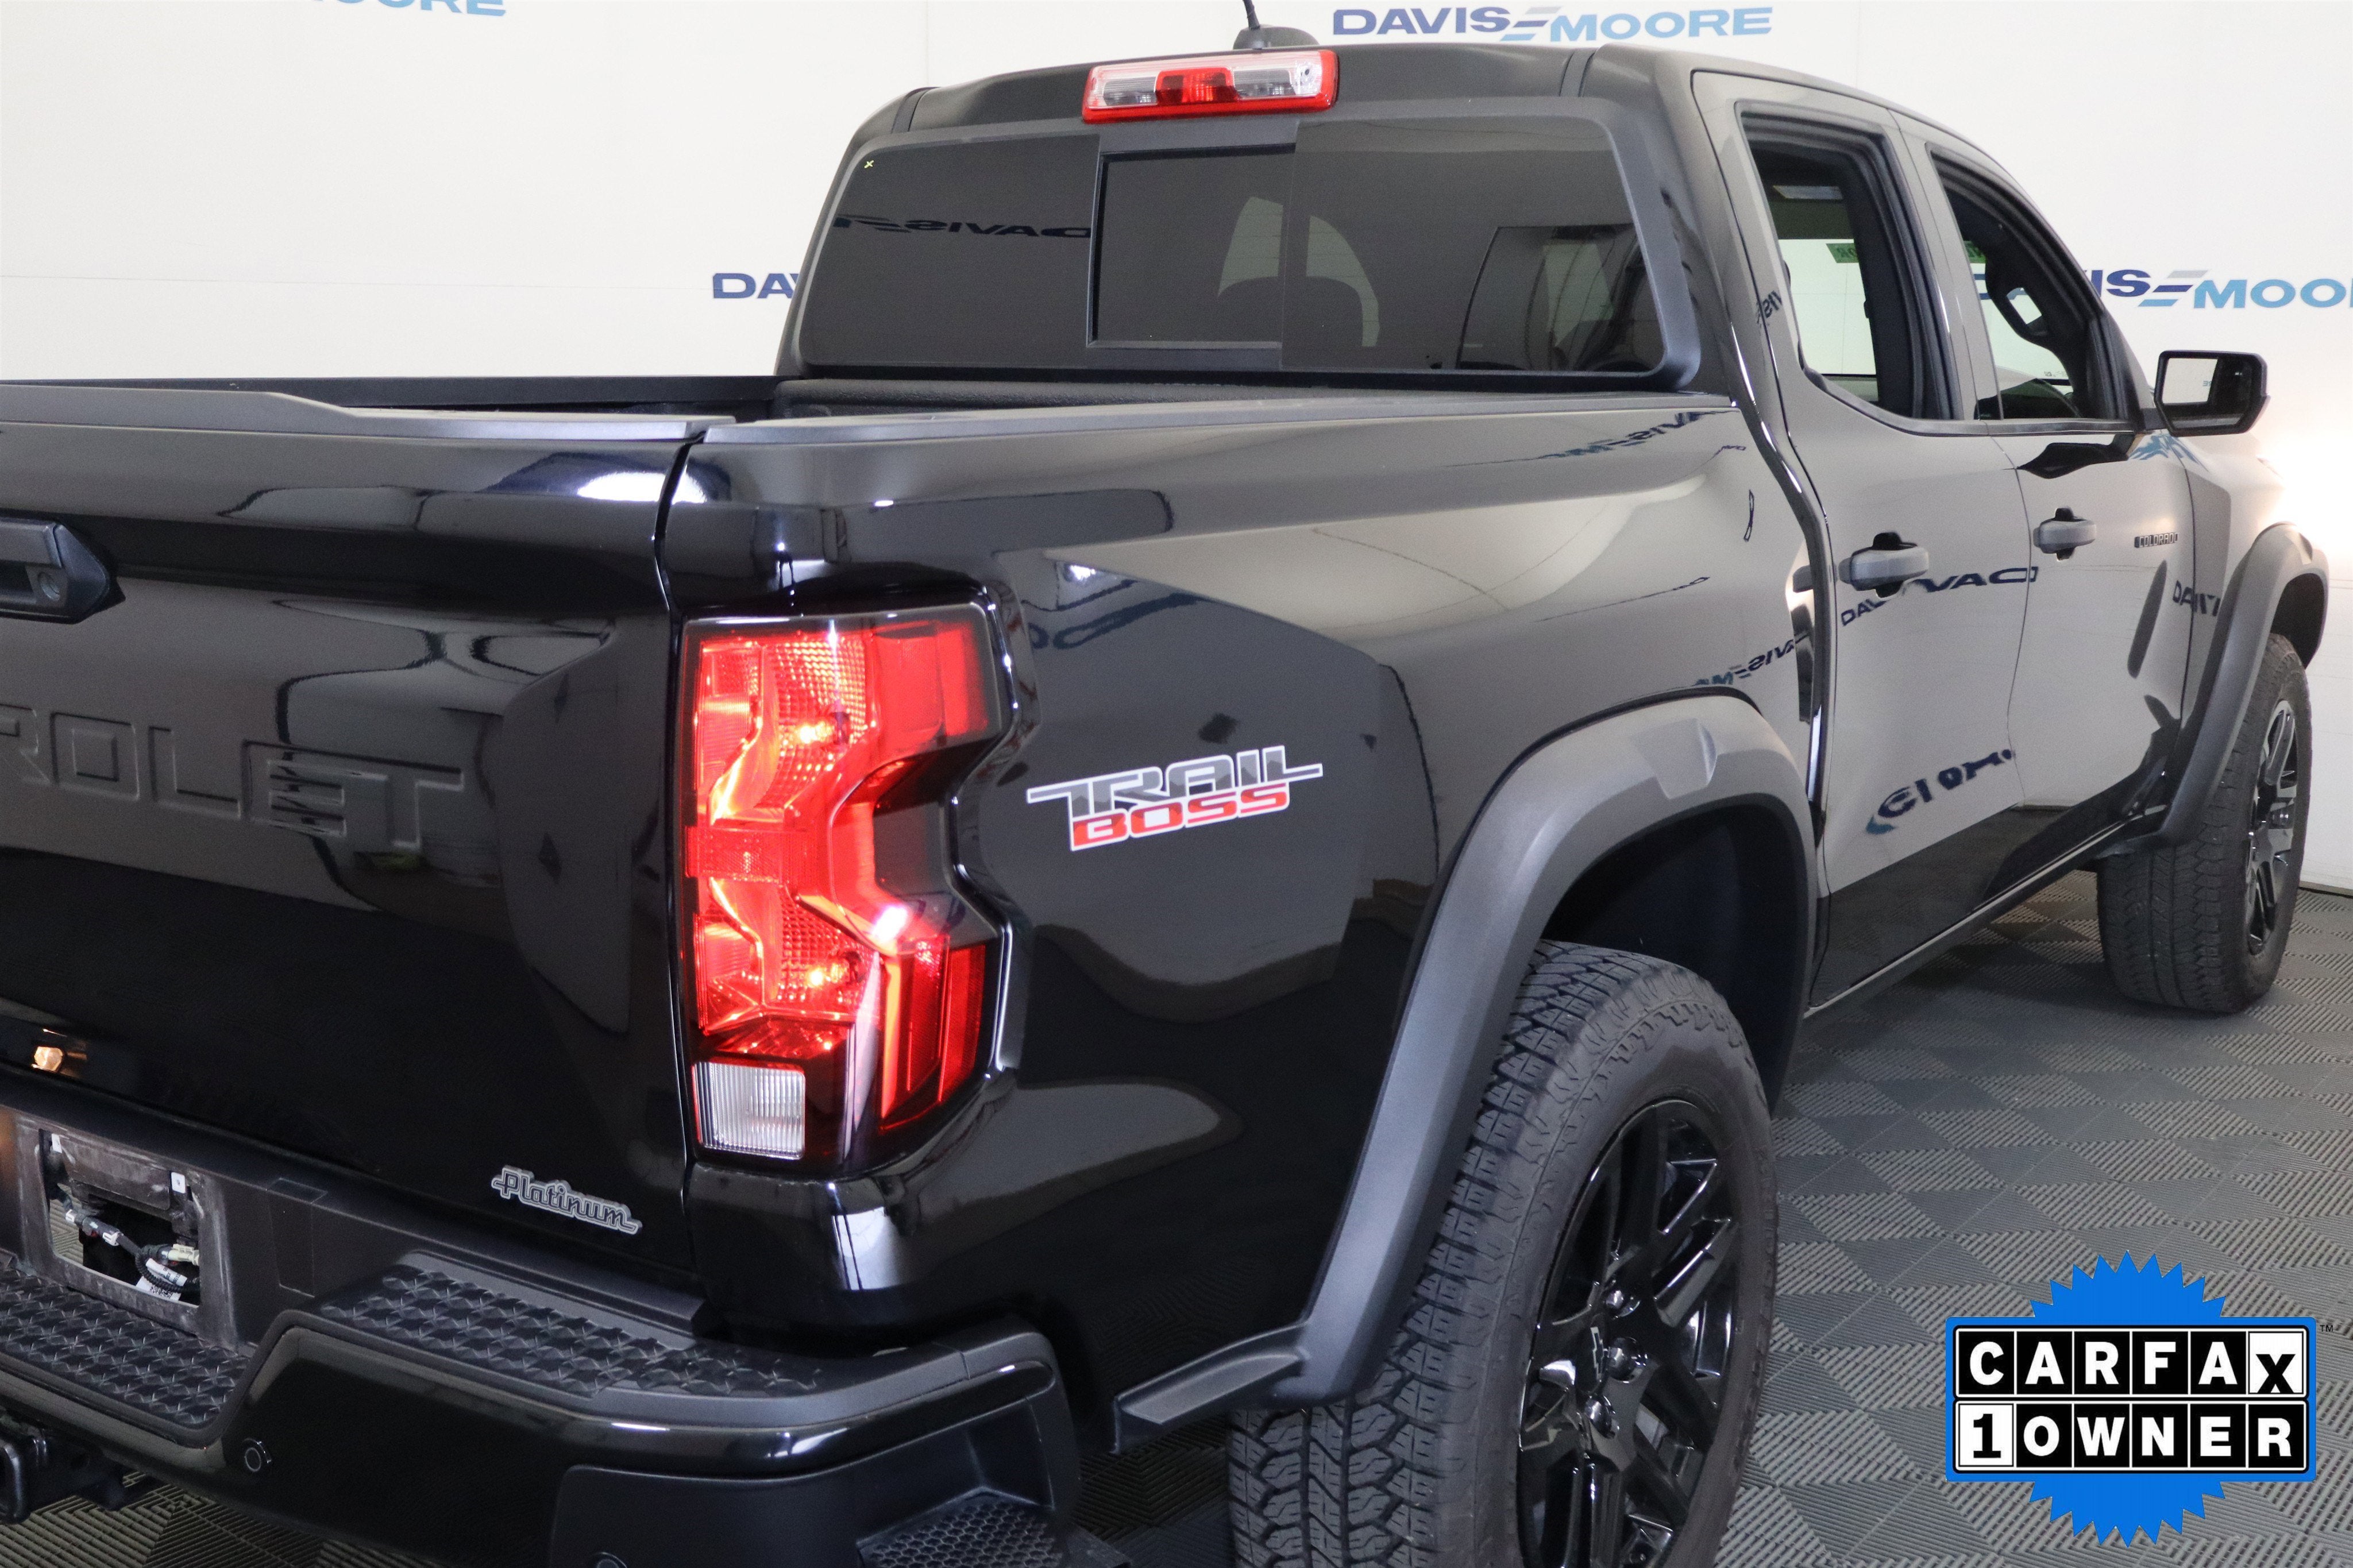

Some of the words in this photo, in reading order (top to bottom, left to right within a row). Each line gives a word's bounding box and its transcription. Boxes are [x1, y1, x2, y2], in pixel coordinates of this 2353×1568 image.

[1333, 7, 1511, 36] DAVIS
[1549, 7, 1773, 42] MOORE
[712, 273, 799, 299] DA
[2193, 278, 2353, 309] MOO
[1027, 746, 1323, 816] TRAIL
[1071, 782, 1290, 851] BOSS
[491, 1165, 643, 1235] Platinum
